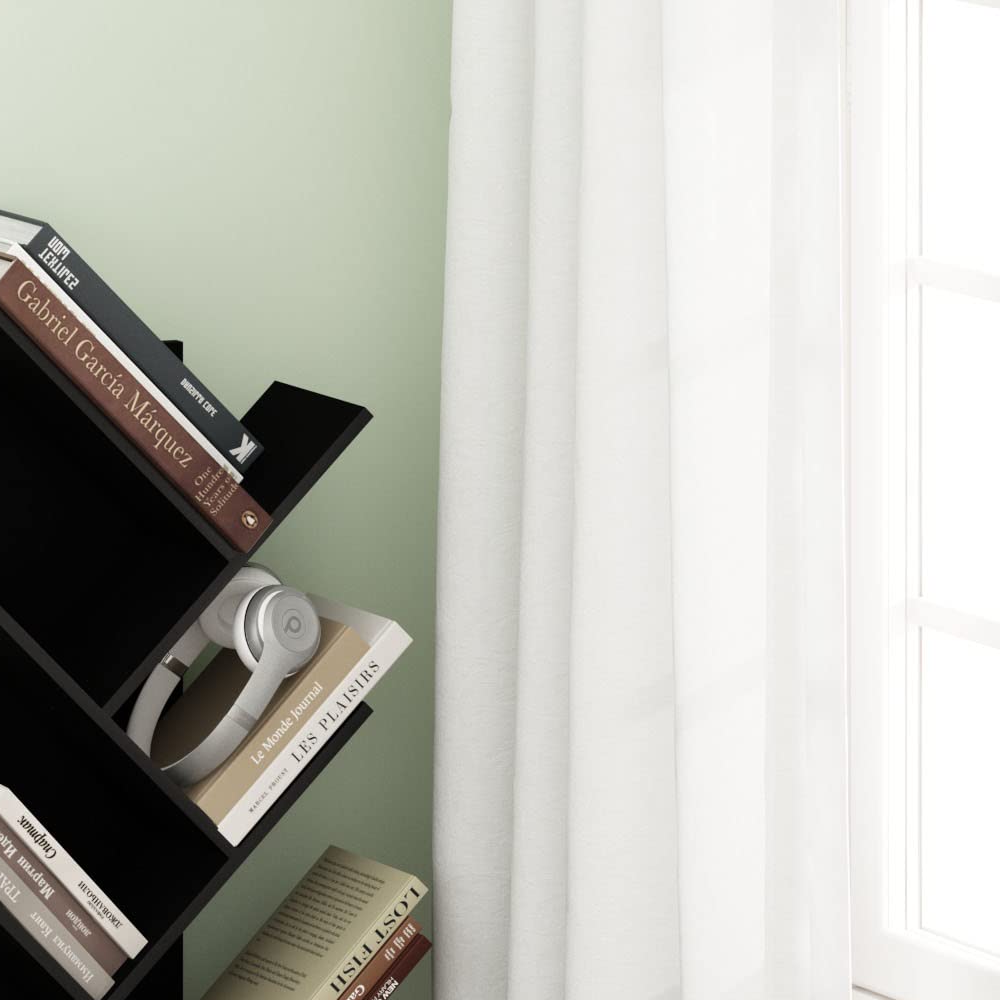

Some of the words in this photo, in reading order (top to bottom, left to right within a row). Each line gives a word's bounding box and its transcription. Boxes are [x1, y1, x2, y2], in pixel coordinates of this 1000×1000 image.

[17, 280, 78, 346] Gabriel
[75, 339, 125, 399] García
[124, 389, 193, 468] Márquez
[194, 466, 212, 486] One
[203, 485, 225, 507] Years
[250, 750, 265, 765] Le
[261, 716, 294, 753] Monde
[290, 681, 324, 722] Journal
[291, 733, 318, 763] LES
[318, 660, 380, 732] PLAISIRS
[17, 815, 57, 859] Спартак
[17, 856, 55, 900] Мартин
[30, 911, 53, 937] Кант
[77, 881, 123, 928] ДЖОВАНЬОЛИ
[375, 887, 420, 944] LOST
[52, 935, 94, 983] Иммануил
[330, 944, 372, 993] FISH
[381, 979, 399, 1000] NEW
